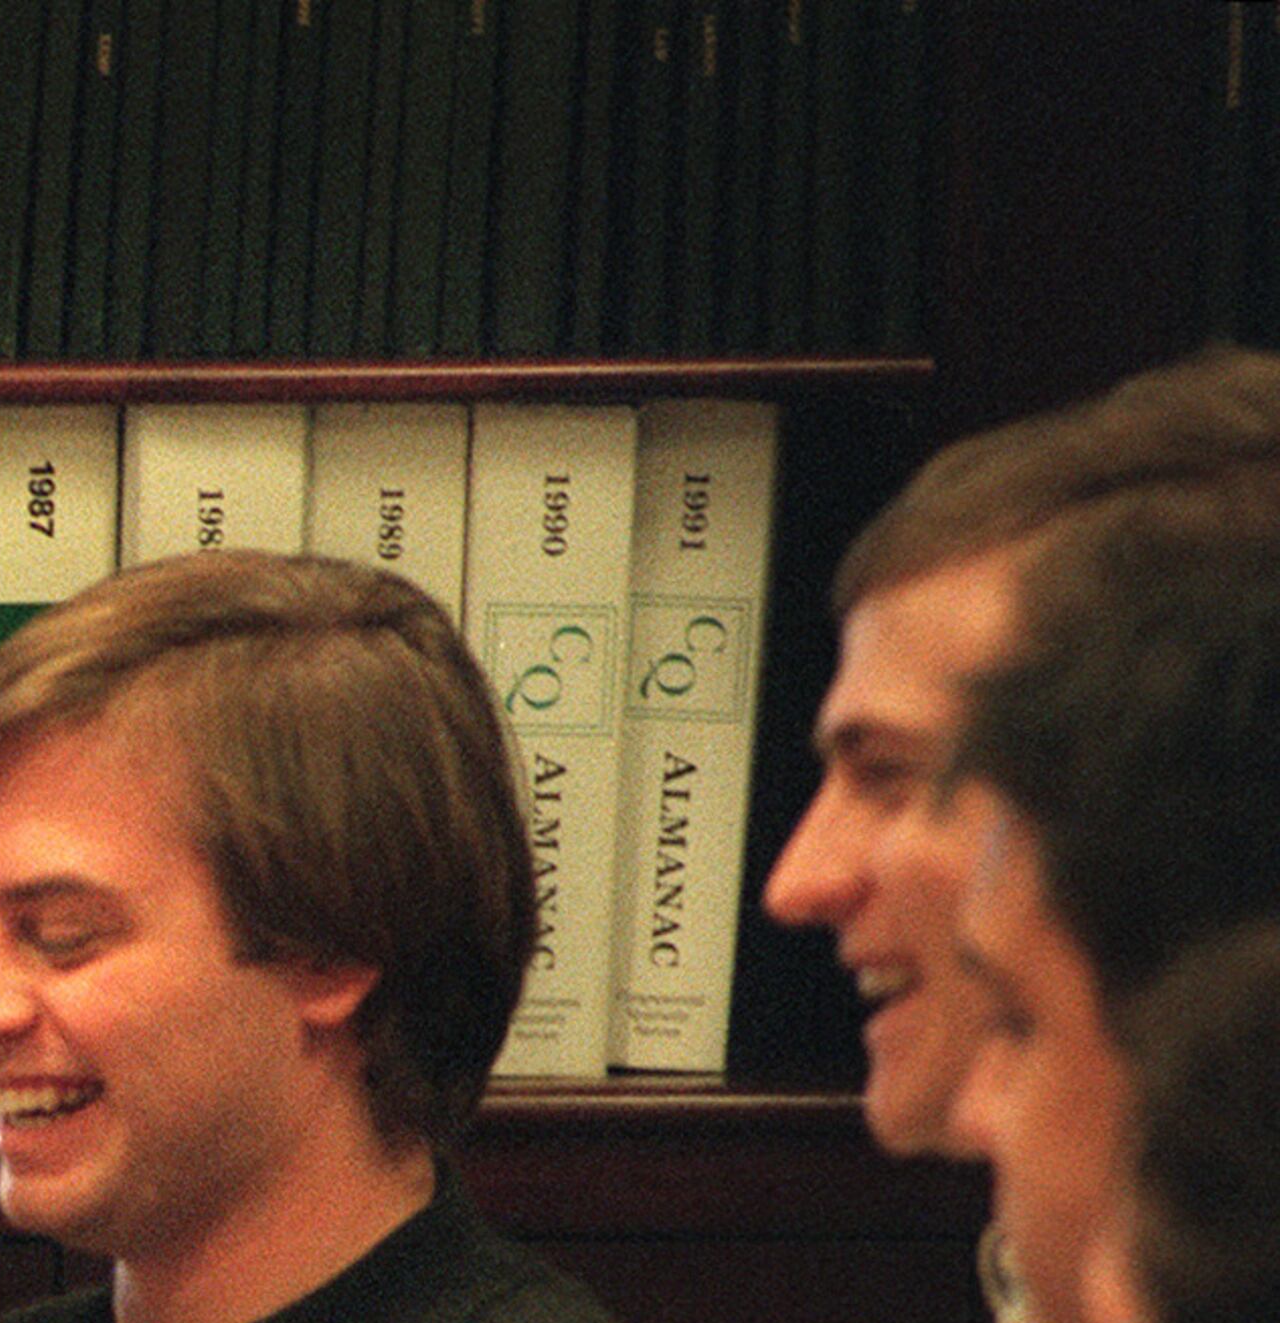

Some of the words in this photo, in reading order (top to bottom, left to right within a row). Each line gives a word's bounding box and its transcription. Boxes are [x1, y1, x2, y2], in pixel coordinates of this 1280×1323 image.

[28, 461, 55, 539] 1987
[197, 487, 225, 550] 198
[377, 488, 405, 561] 1989
[540, 472, 571, 558] 1990
[679, 471, 710, 552] 1991
[649, 751, 698, 968] ALMANAC
